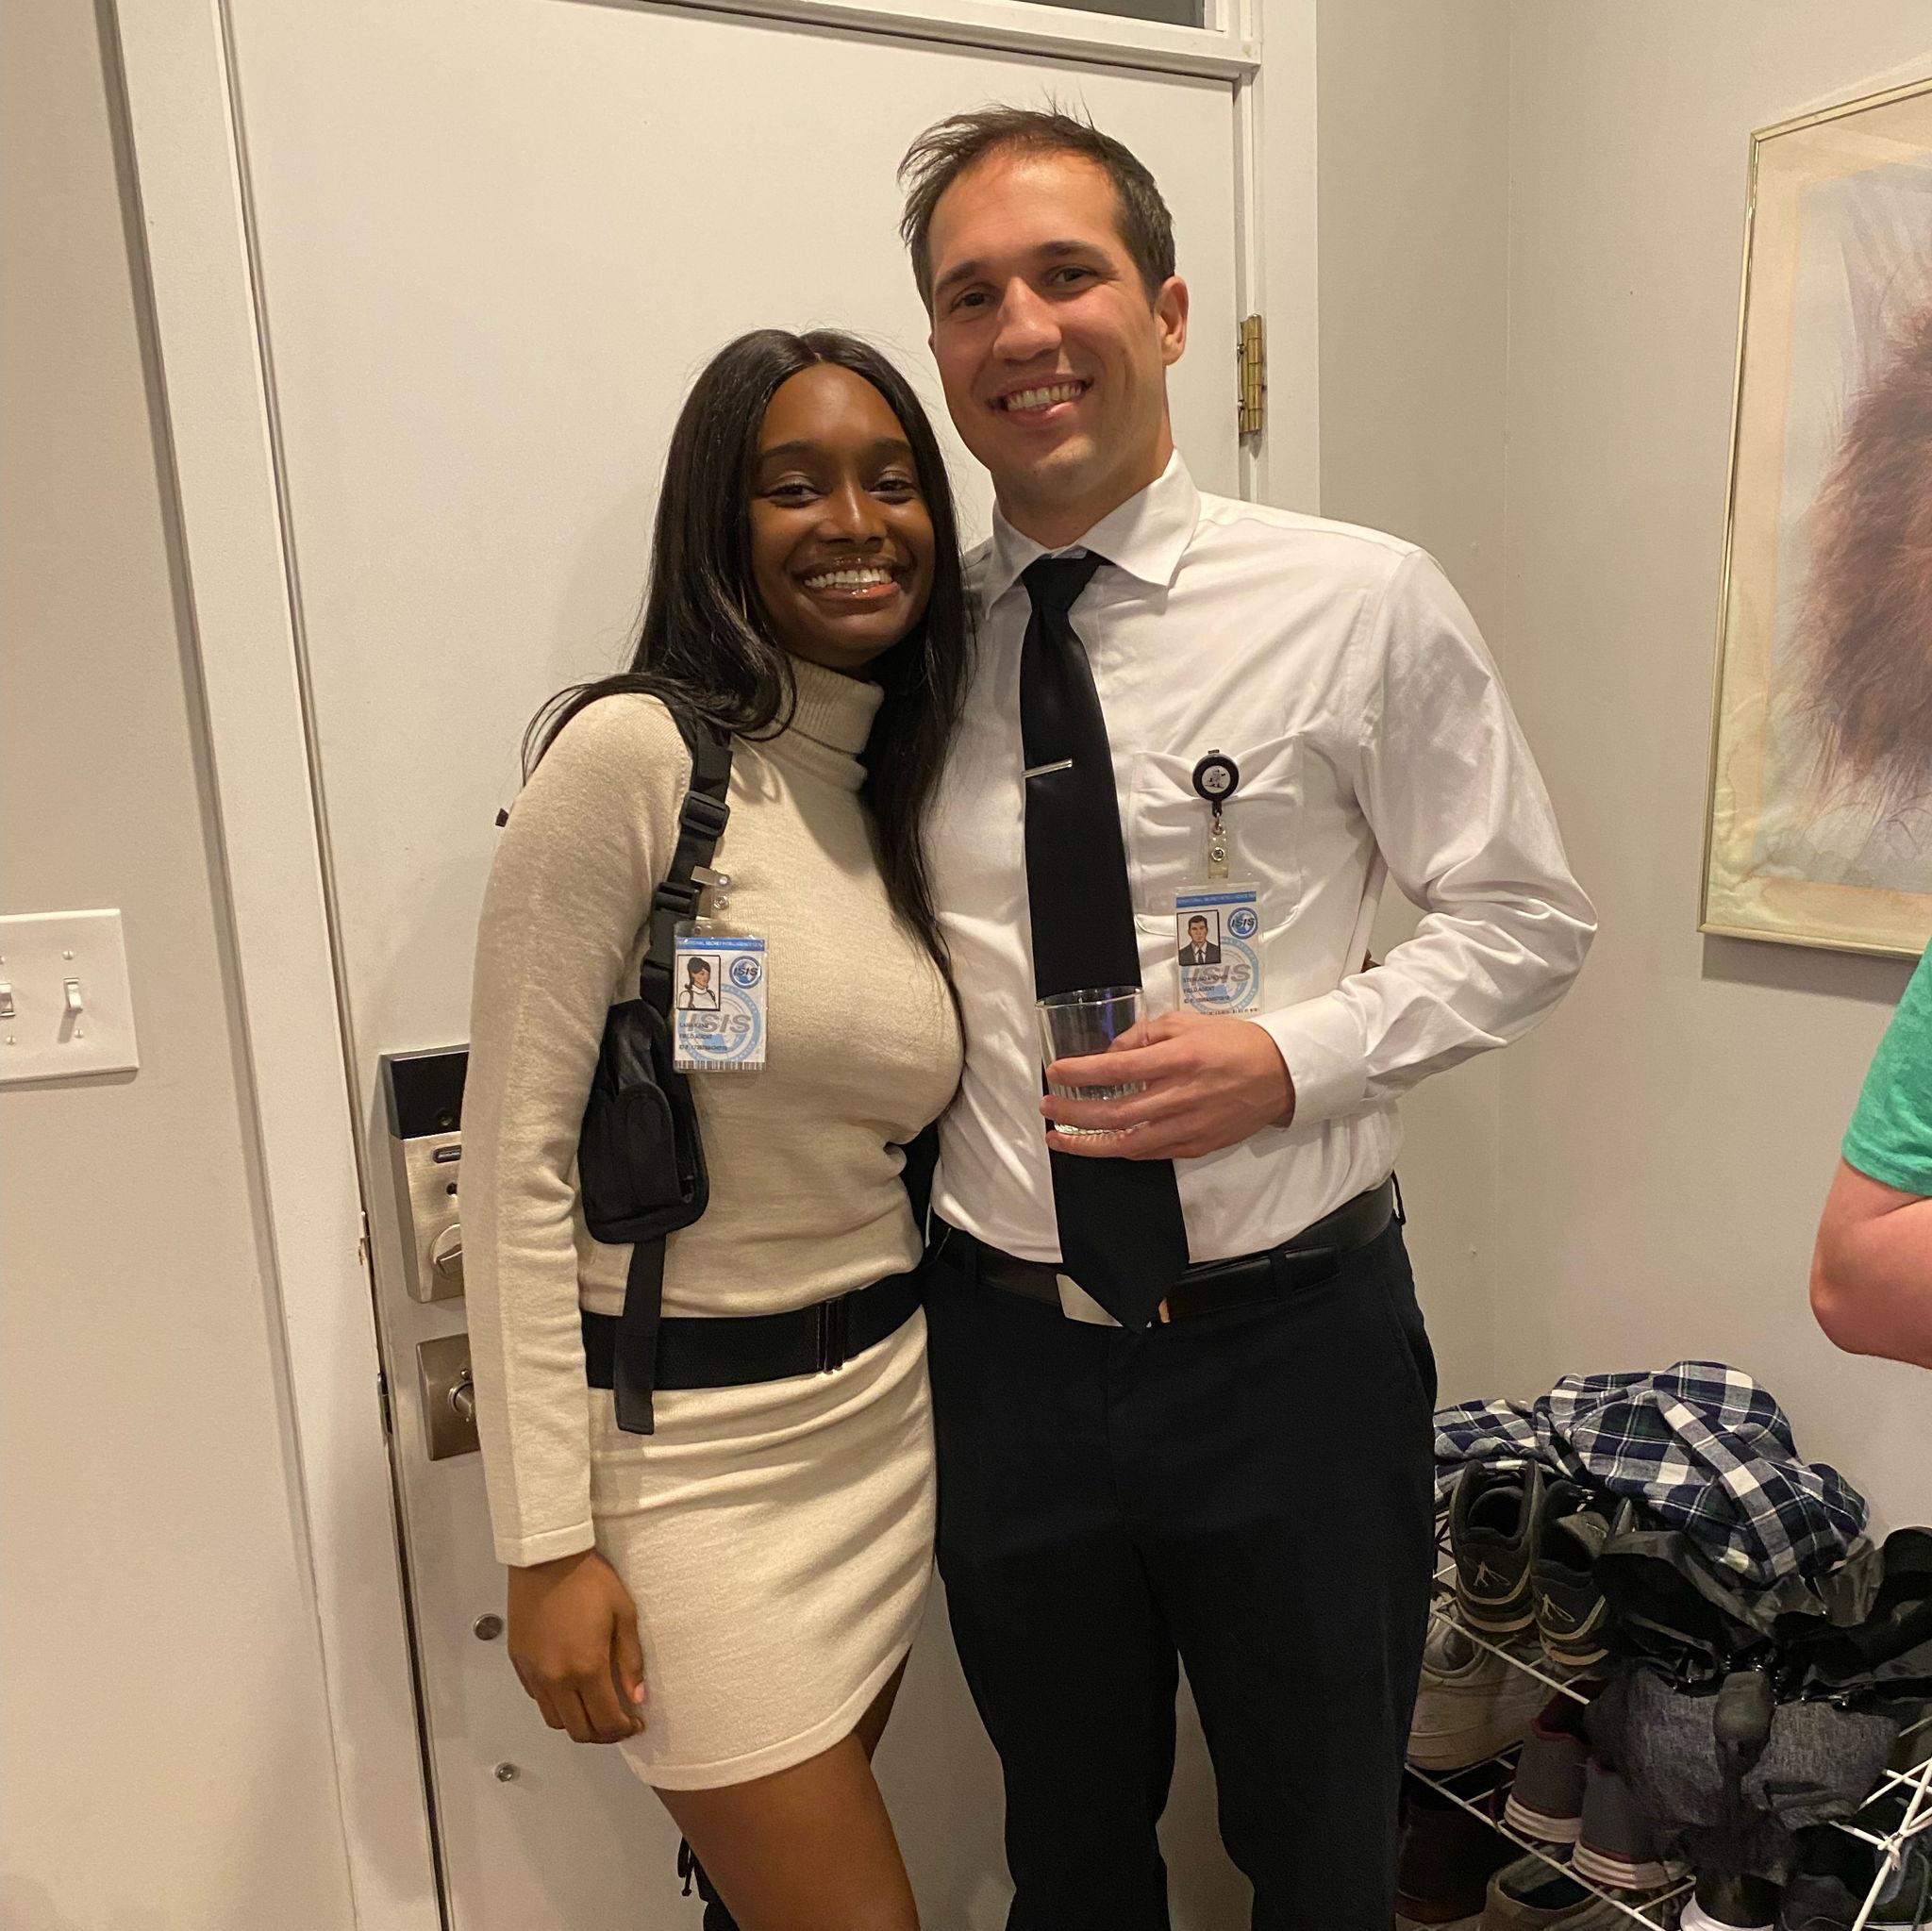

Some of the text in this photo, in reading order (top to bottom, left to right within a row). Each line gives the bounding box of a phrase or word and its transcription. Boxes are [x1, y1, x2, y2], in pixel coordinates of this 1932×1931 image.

[1231, 917, 1256, 928] ISIS
[734, 967, 758, 976] ISIS
[1191, 963, 1251, 987] ISIS
[687, 1013, 752, 1034] ISIS
